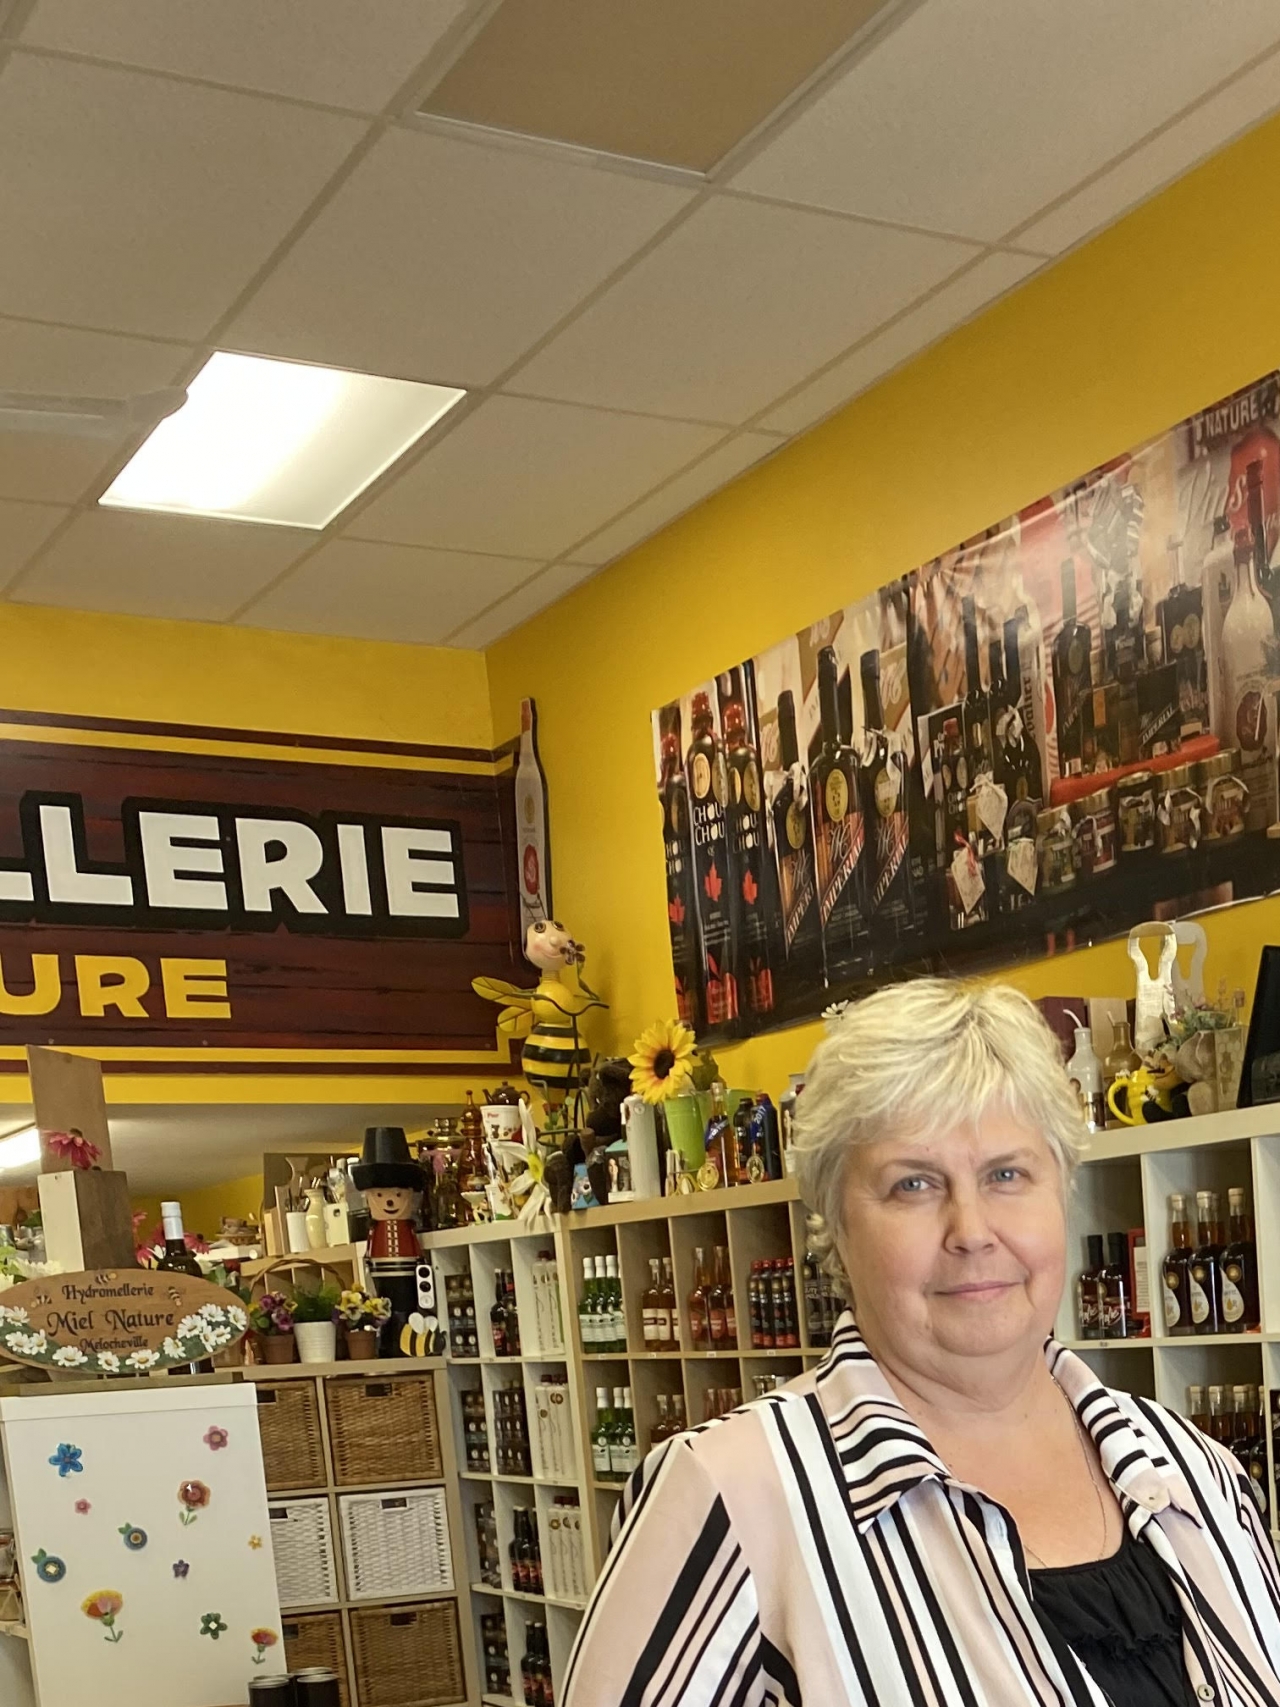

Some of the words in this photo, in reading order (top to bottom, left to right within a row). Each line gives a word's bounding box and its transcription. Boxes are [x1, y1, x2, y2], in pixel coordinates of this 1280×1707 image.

[62, 1283, 153, 1304] Hydromellerie
[47, 1311, 94, 1336] Miel
[105, 1309, 175, 1333] Nature
